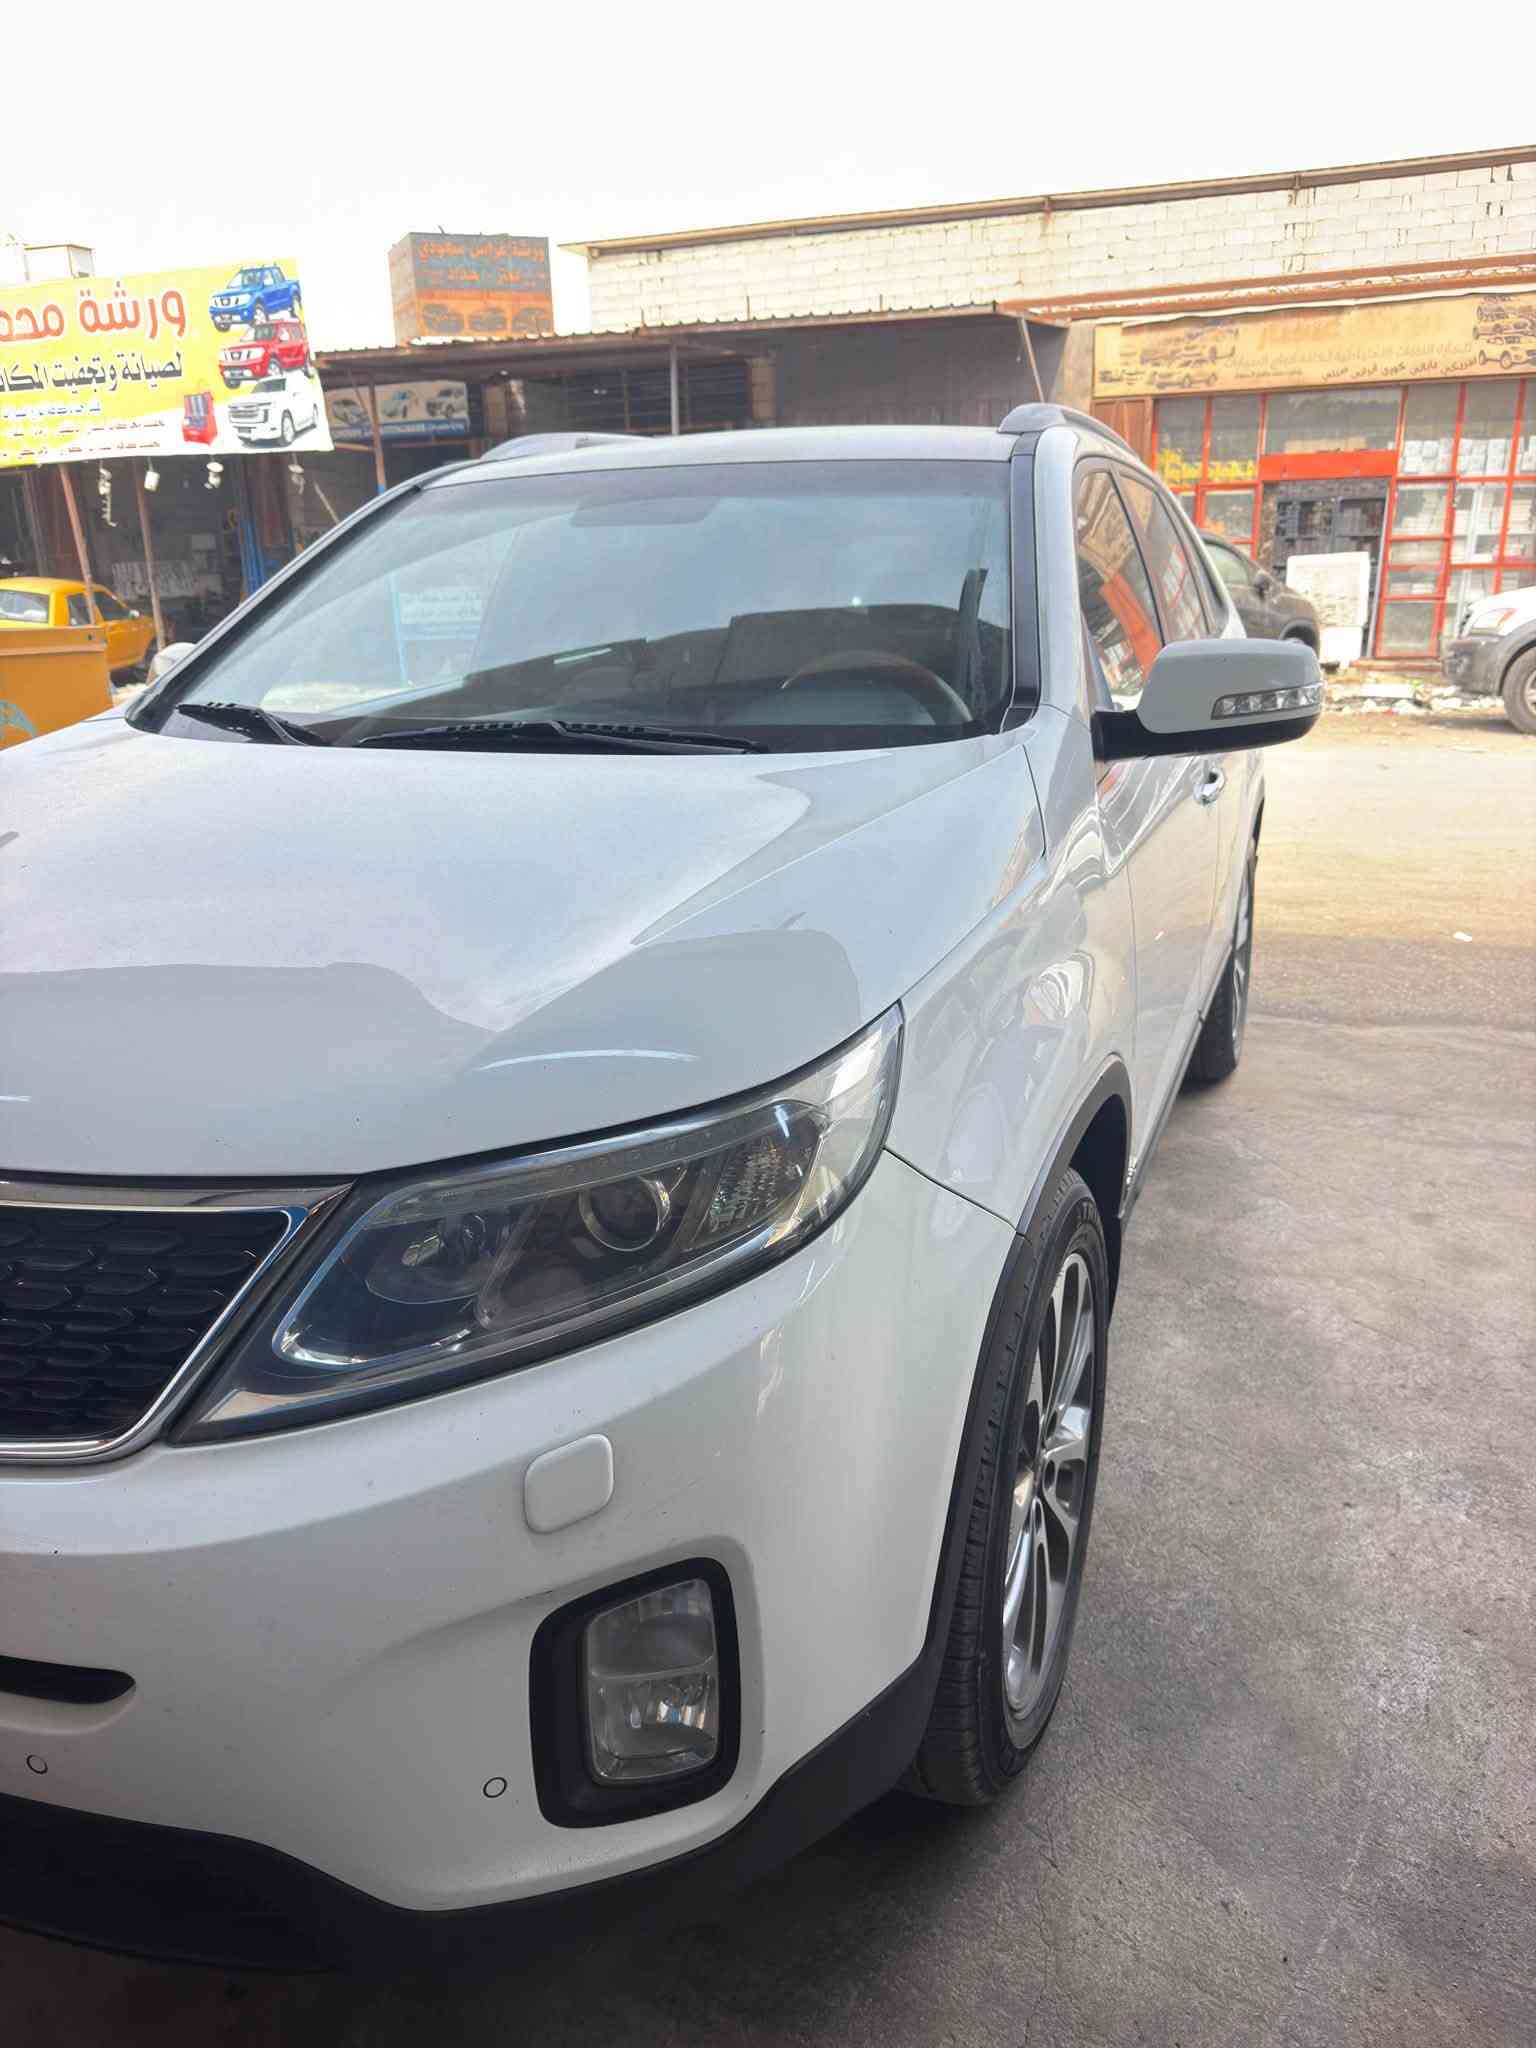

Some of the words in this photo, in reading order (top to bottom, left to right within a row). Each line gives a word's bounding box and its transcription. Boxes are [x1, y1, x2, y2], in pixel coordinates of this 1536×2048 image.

[0, 302, 65, 342] محم
[79, 281, 186, 340] ورشة
[118, 351, 183, 388] لصيانة
